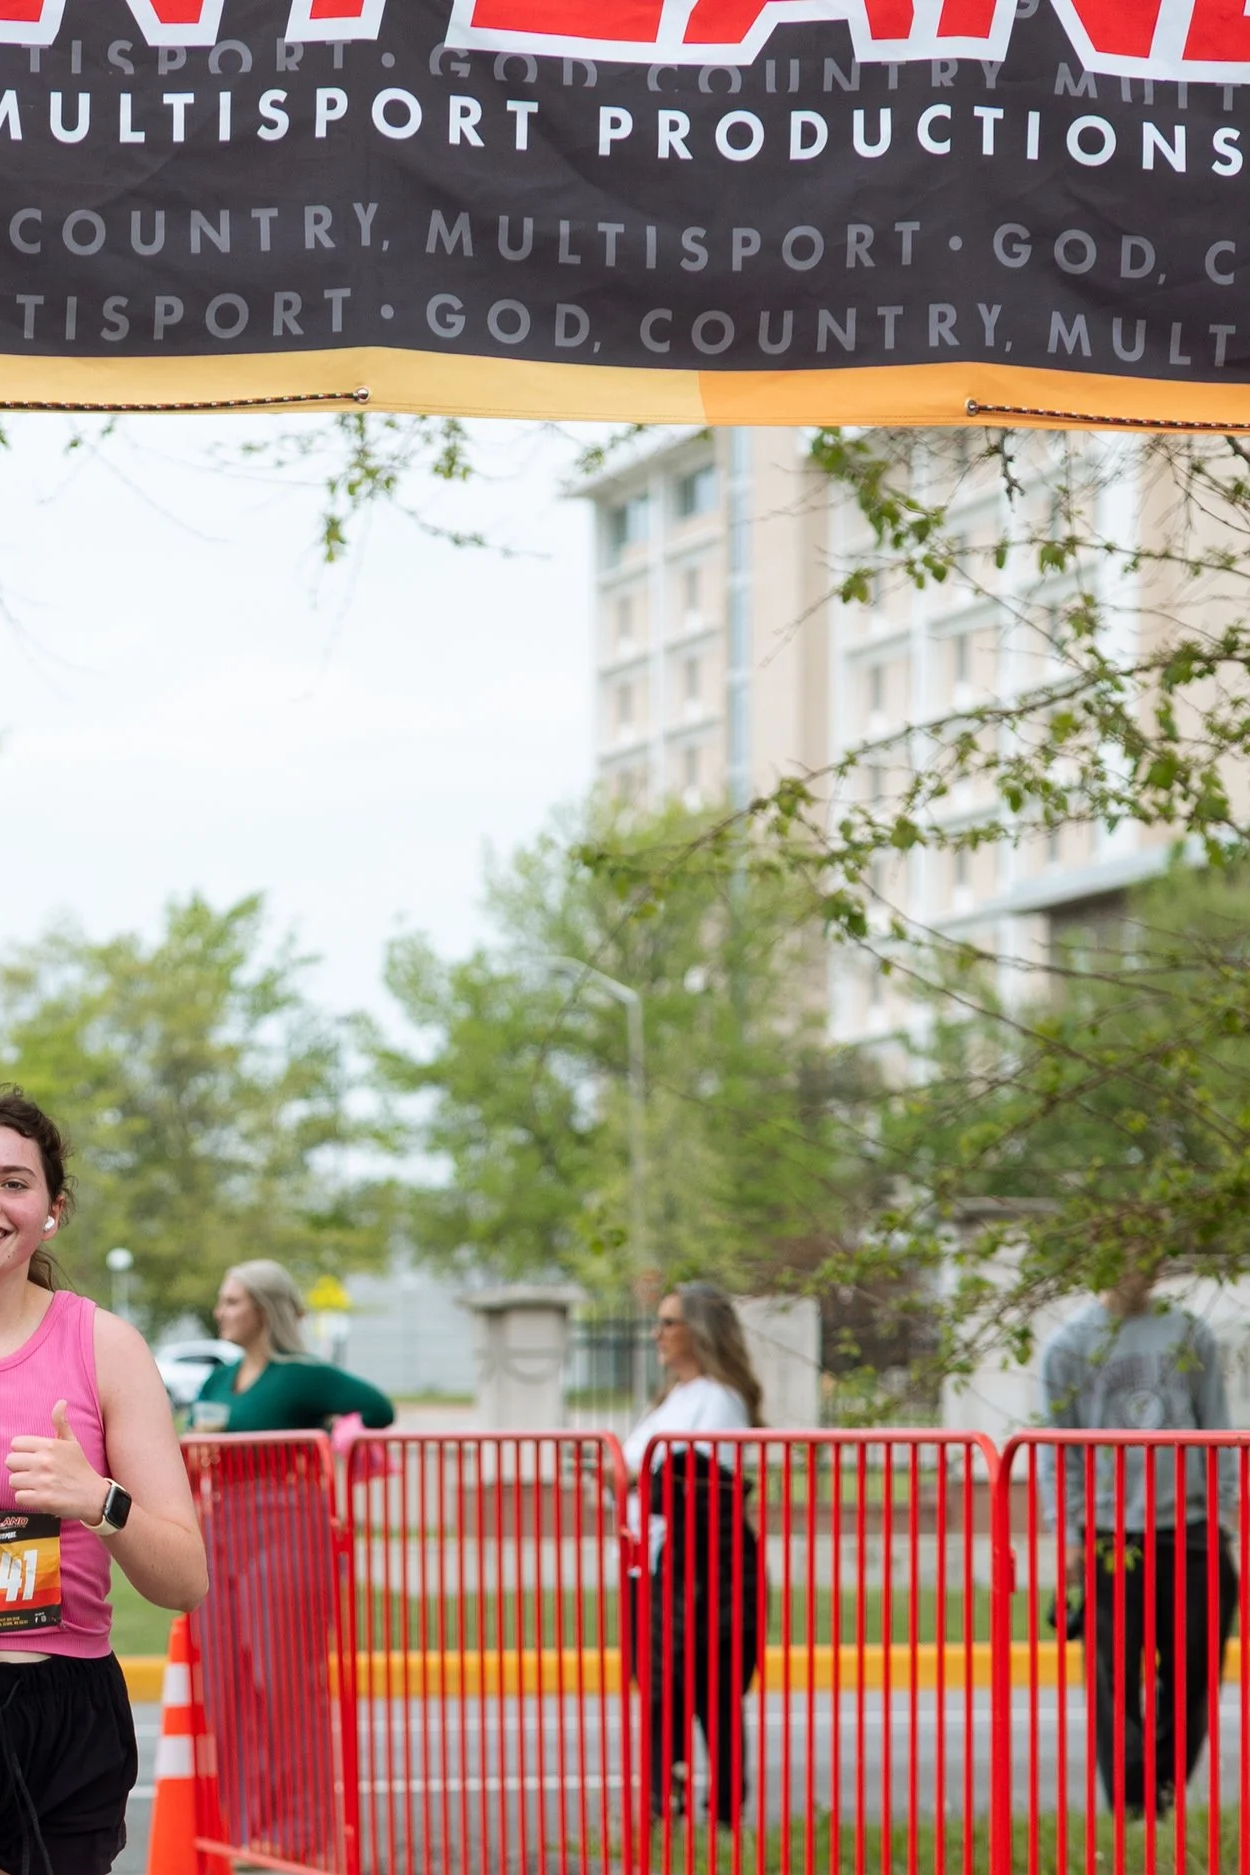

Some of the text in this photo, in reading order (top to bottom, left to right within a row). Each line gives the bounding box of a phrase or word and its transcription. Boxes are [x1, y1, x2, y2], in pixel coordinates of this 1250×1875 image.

[598, 103, 1244, 177] PRODUCTIONS
[9, 202, 389, 256] COUNTRY,
[425, 209, 920, 272] MULTISPORT
[993, 223, 1166, 284] GOD,
[425, 293, 601, 353] GOD,
[640, 302, 1012, 355] COUNTRY,
[1047, 311, 1236, 367] MULT
